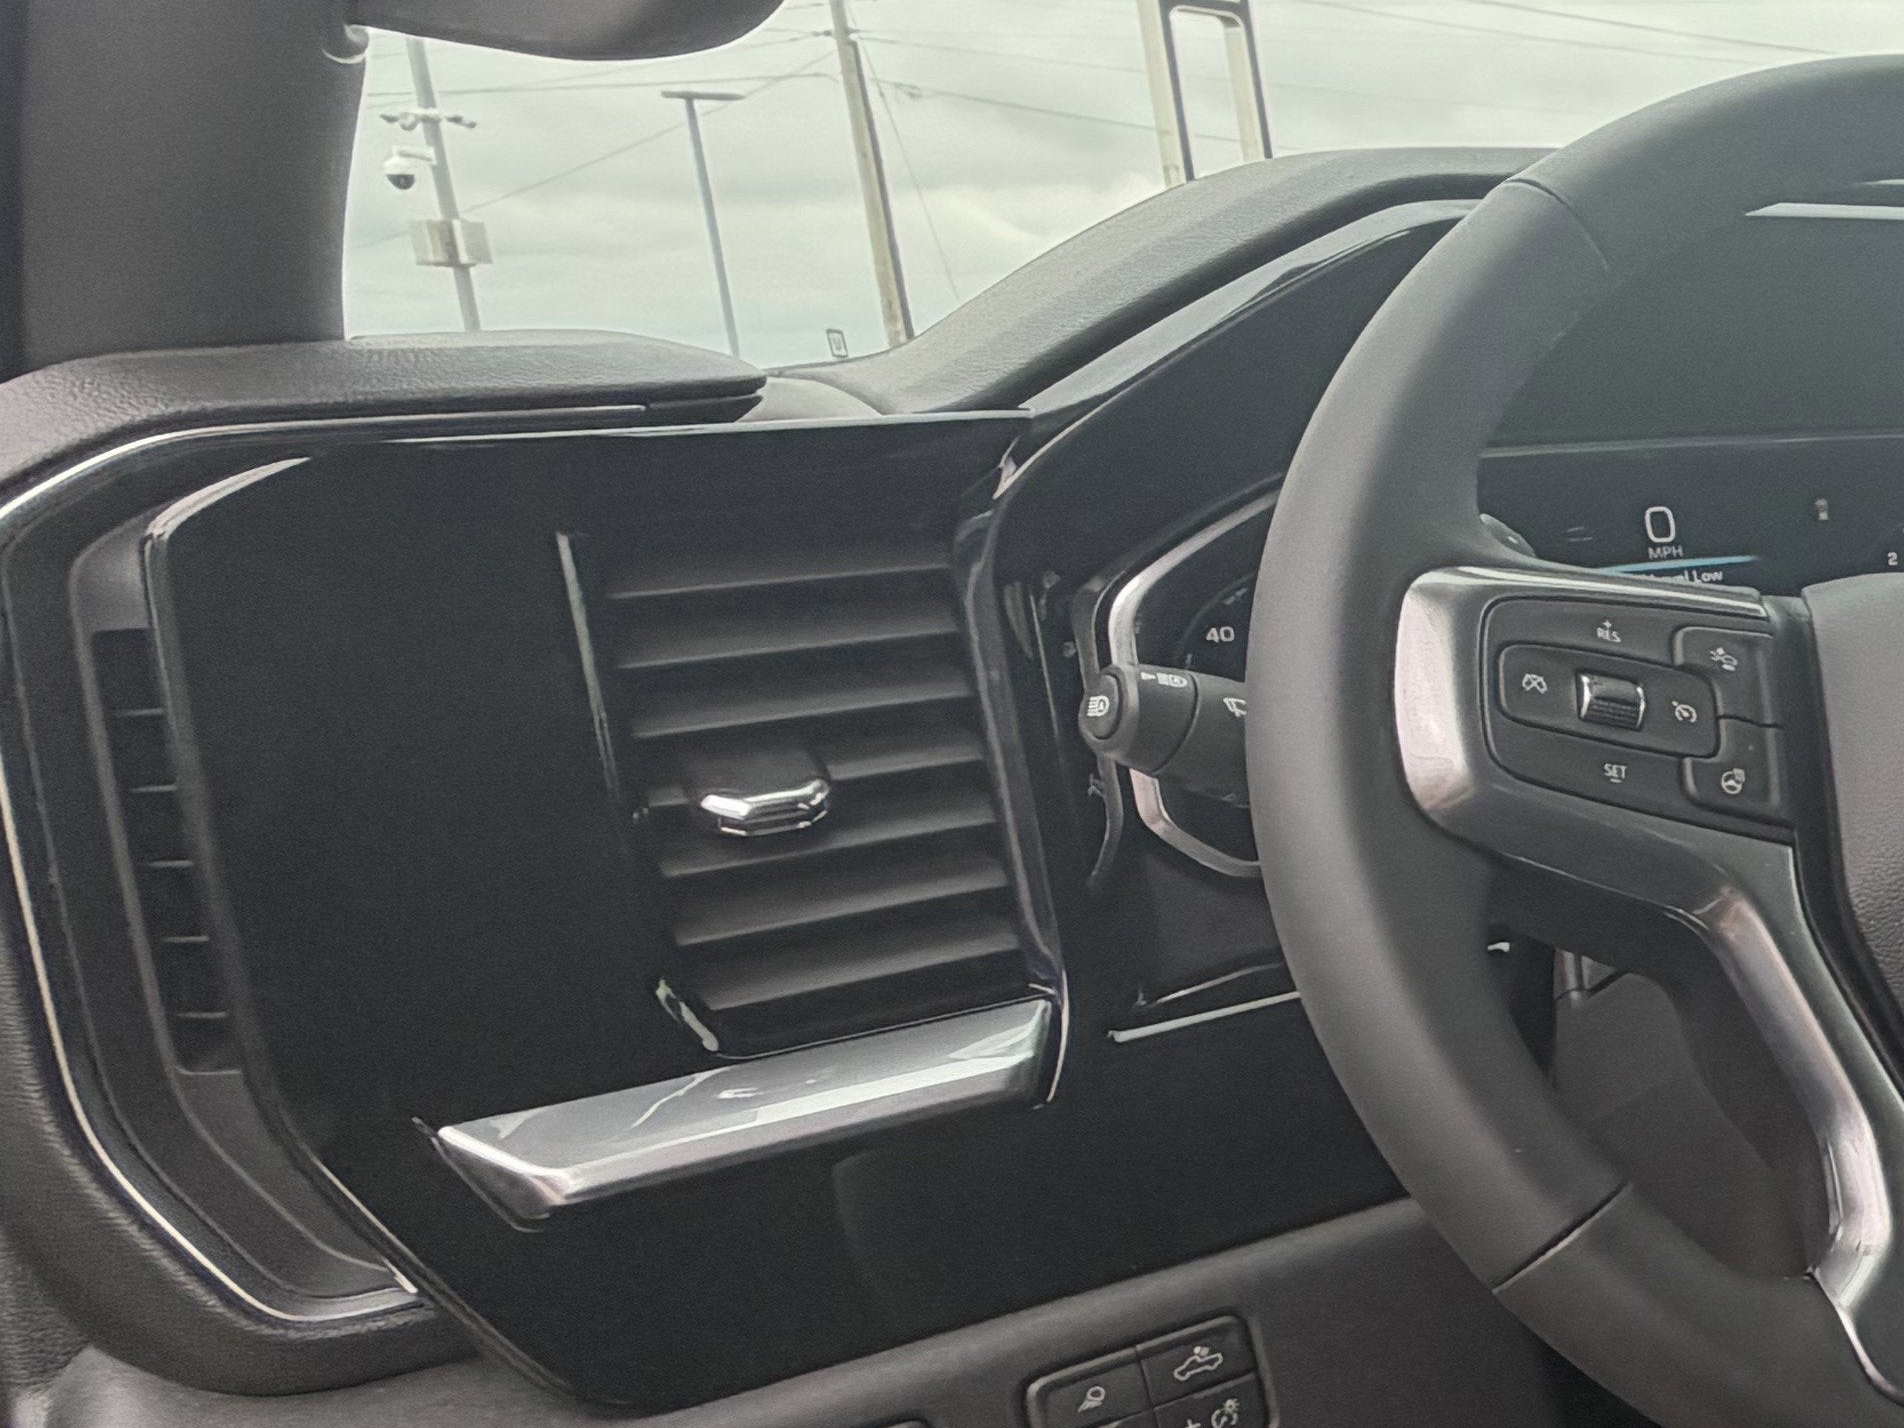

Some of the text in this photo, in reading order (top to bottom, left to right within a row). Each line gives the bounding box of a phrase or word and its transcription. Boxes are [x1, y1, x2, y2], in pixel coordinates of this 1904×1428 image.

[1645, 506, 1676, 543] 0
[1648, 545, 1683, 559] MPH
[1887, 551, 1899, 567] 2
[1205, 626, 1235, 643] 40
[1604, 764, 1626, 778] SET
